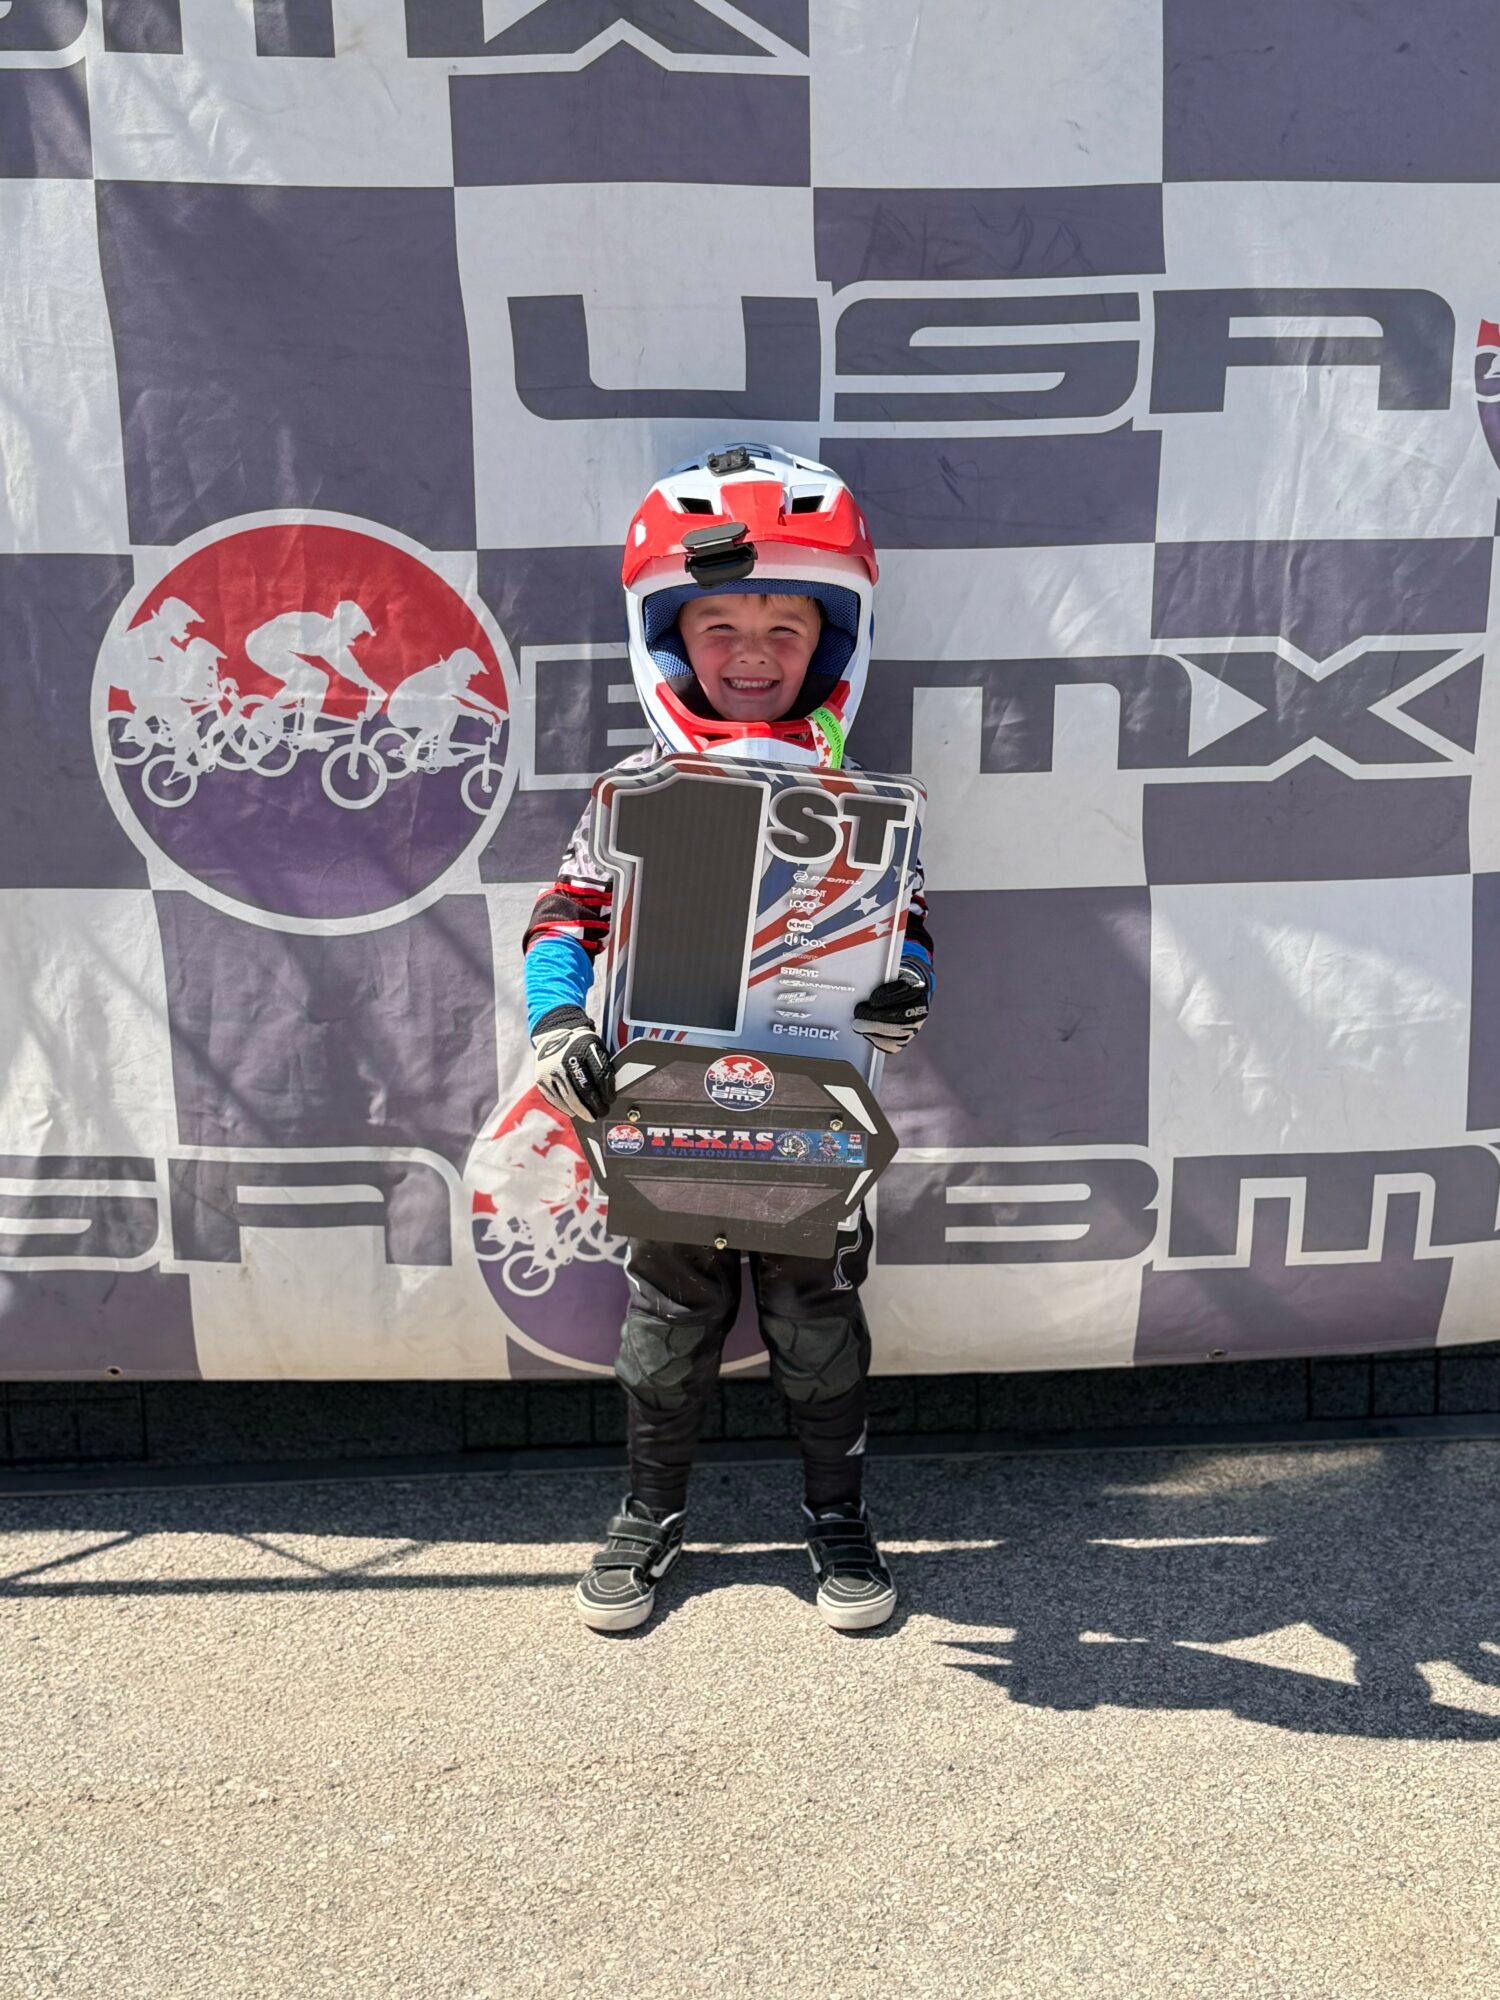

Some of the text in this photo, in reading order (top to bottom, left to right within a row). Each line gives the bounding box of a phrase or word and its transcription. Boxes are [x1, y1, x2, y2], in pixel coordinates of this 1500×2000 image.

[507, 287, 1456, 422] USA
[791, 886, 827, 898] TANGENT
[789, 899, 816, 910] LOCO
[788, 921, 812, 930] KMC
[800, 935, 827, 949] box
[773, 1023, 840, 1041] G-SHOCK
[647, 1126, 774, 1151] TEXAS
[666, 1148, 756, 1159] NATIONALS
[0, 1144, 1500, 1266] SA BM
